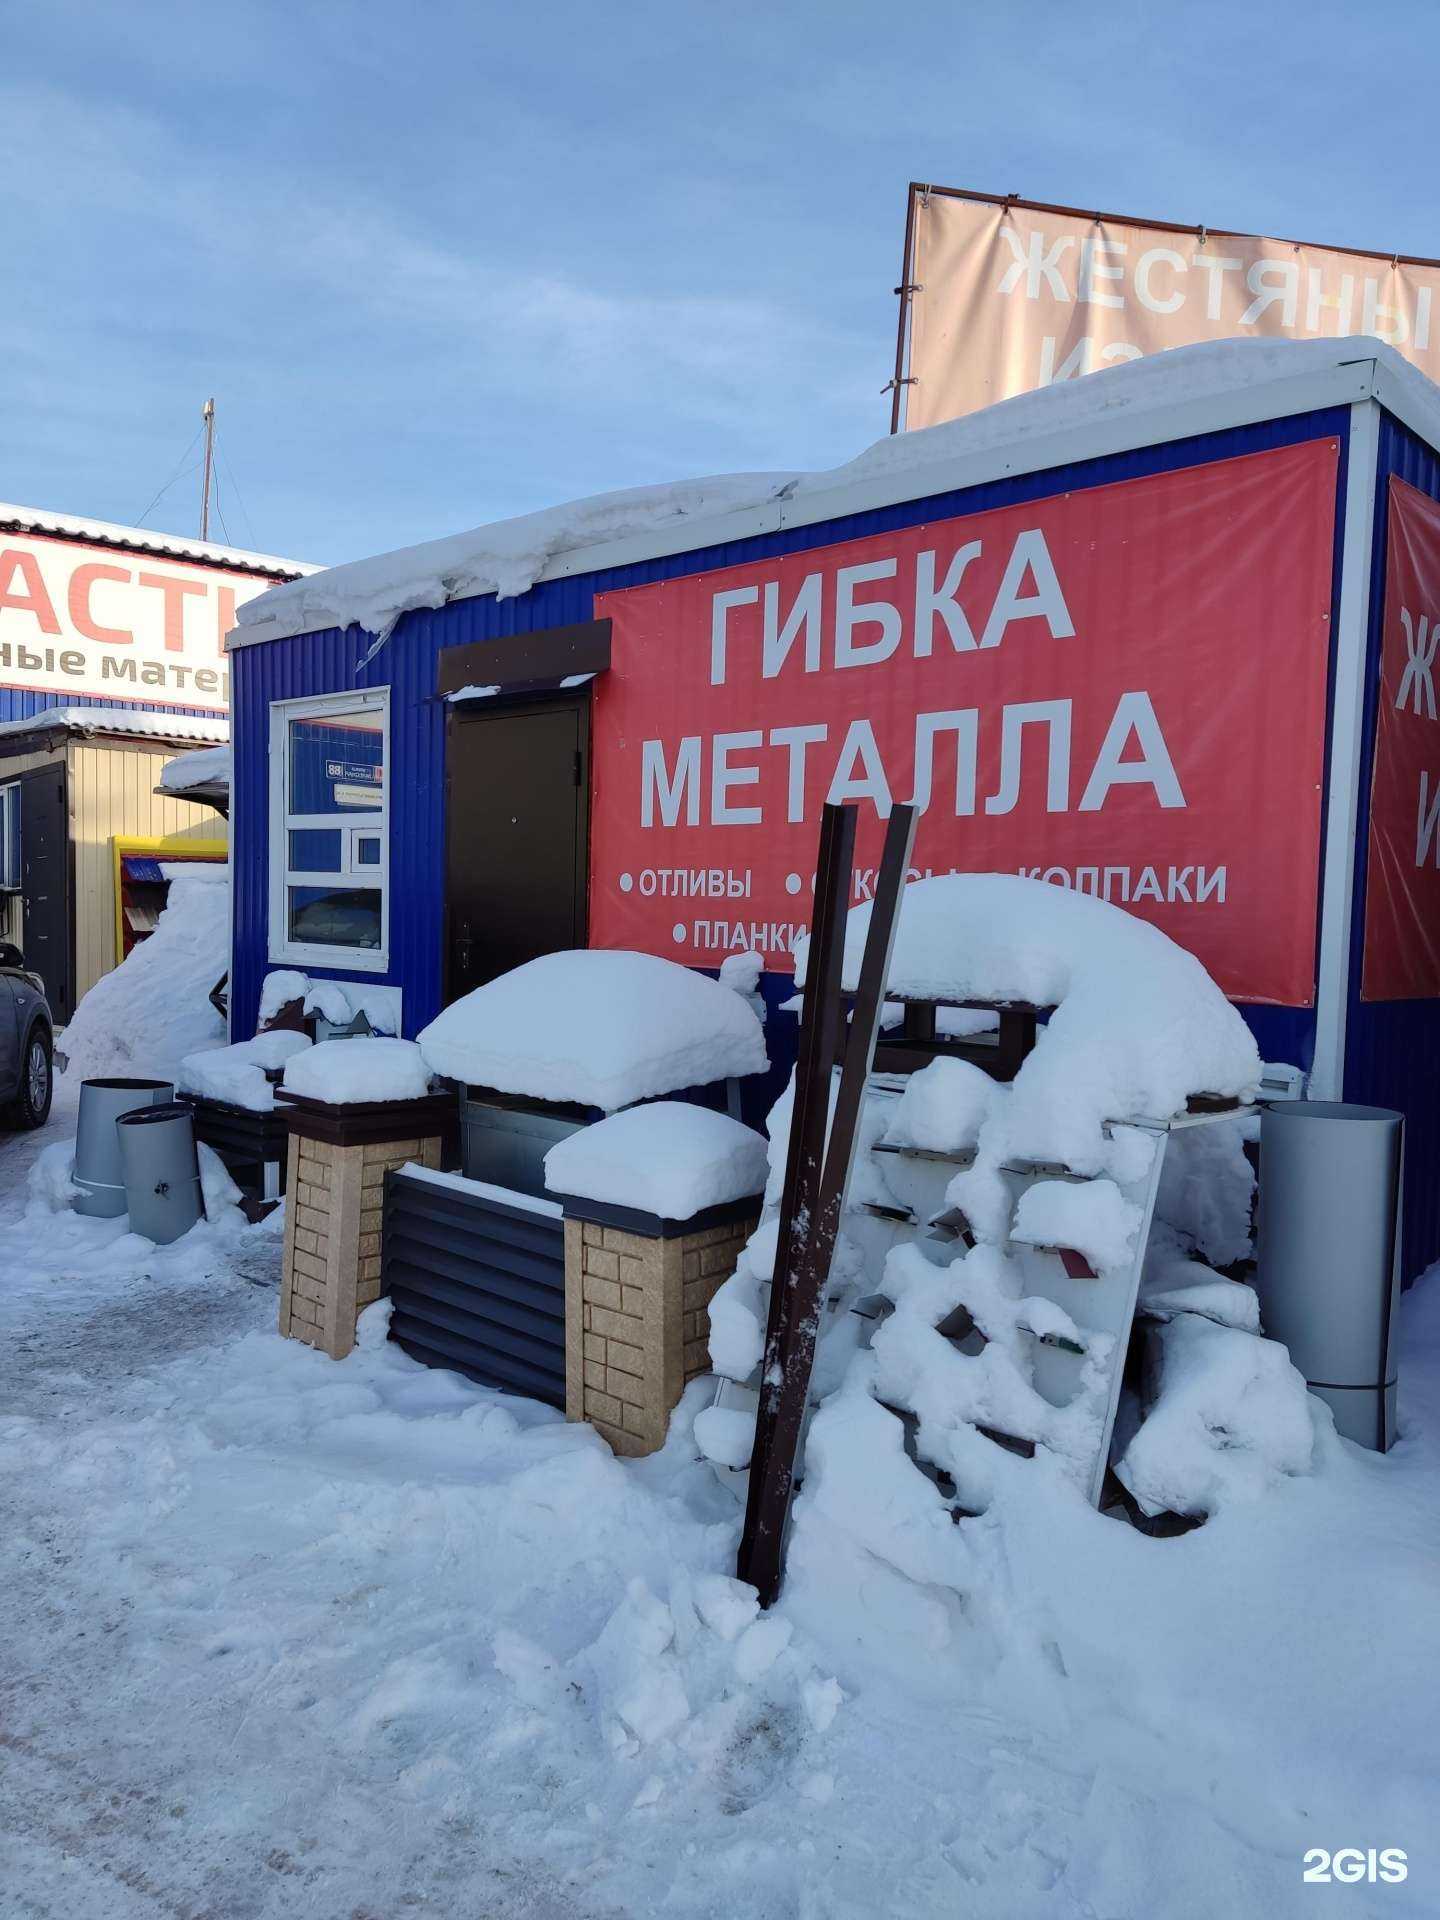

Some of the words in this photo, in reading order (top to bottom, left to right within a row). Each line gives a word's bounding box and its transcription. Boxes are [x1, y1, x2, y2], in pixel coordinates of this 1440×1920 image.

[997, 227, 1432, 350] ЖЕСТЯНЫ
[710, 528, 1076, 685] ГИБКА
[641, 691, 1187, 828] МЕТАЛЛА
[639, 869, 752, 898] ОТЛИВЫ
[693, 920, 808, 952] ПЛАНКИ
